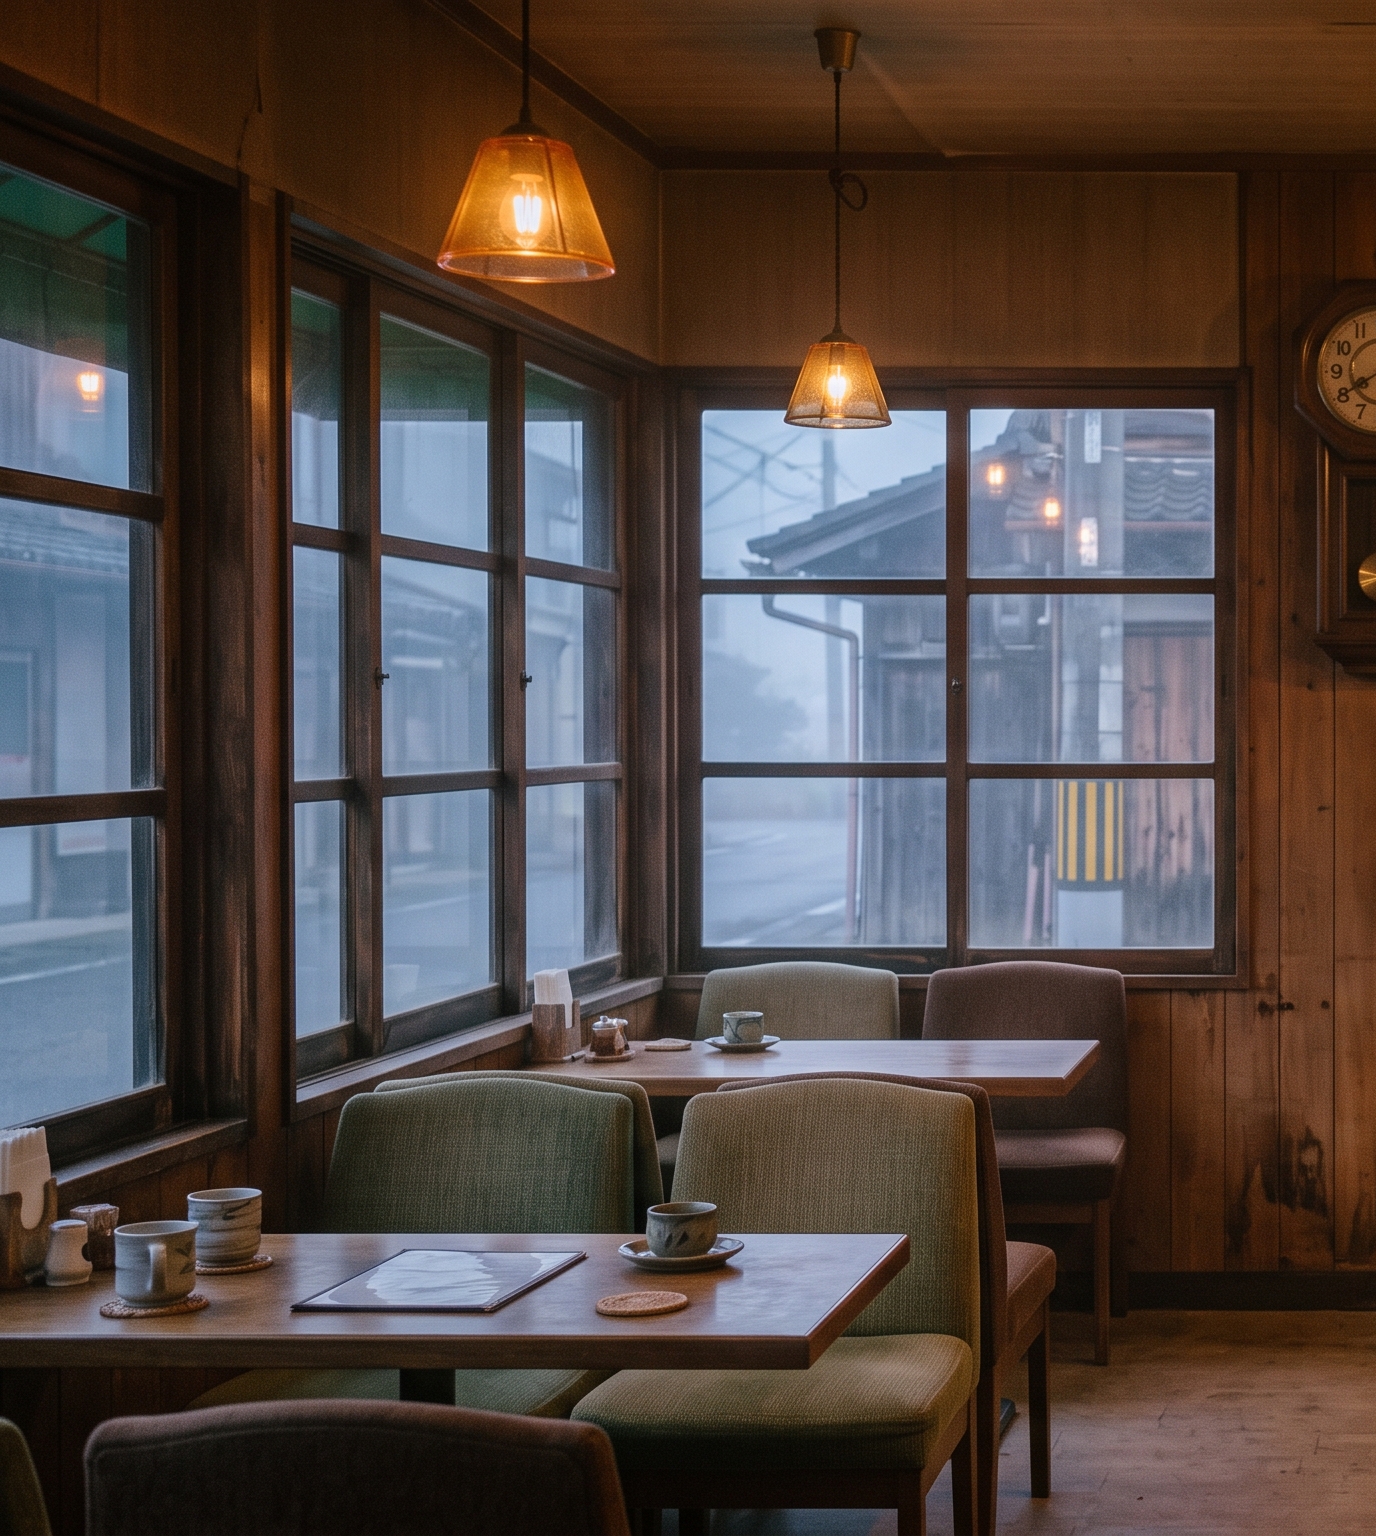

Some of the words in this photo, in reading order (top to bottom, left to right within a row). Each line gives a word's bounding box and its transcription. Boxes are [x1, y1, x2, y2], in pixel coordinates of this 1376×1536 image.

[1355, 323, 1366, 338] 11
[1337, 340, 1351, 356] 10
[1330, 364, 1343, 379] 9
[1337, 387, 1350, 403] 8
[1355, 404, 1367, 419] 7
